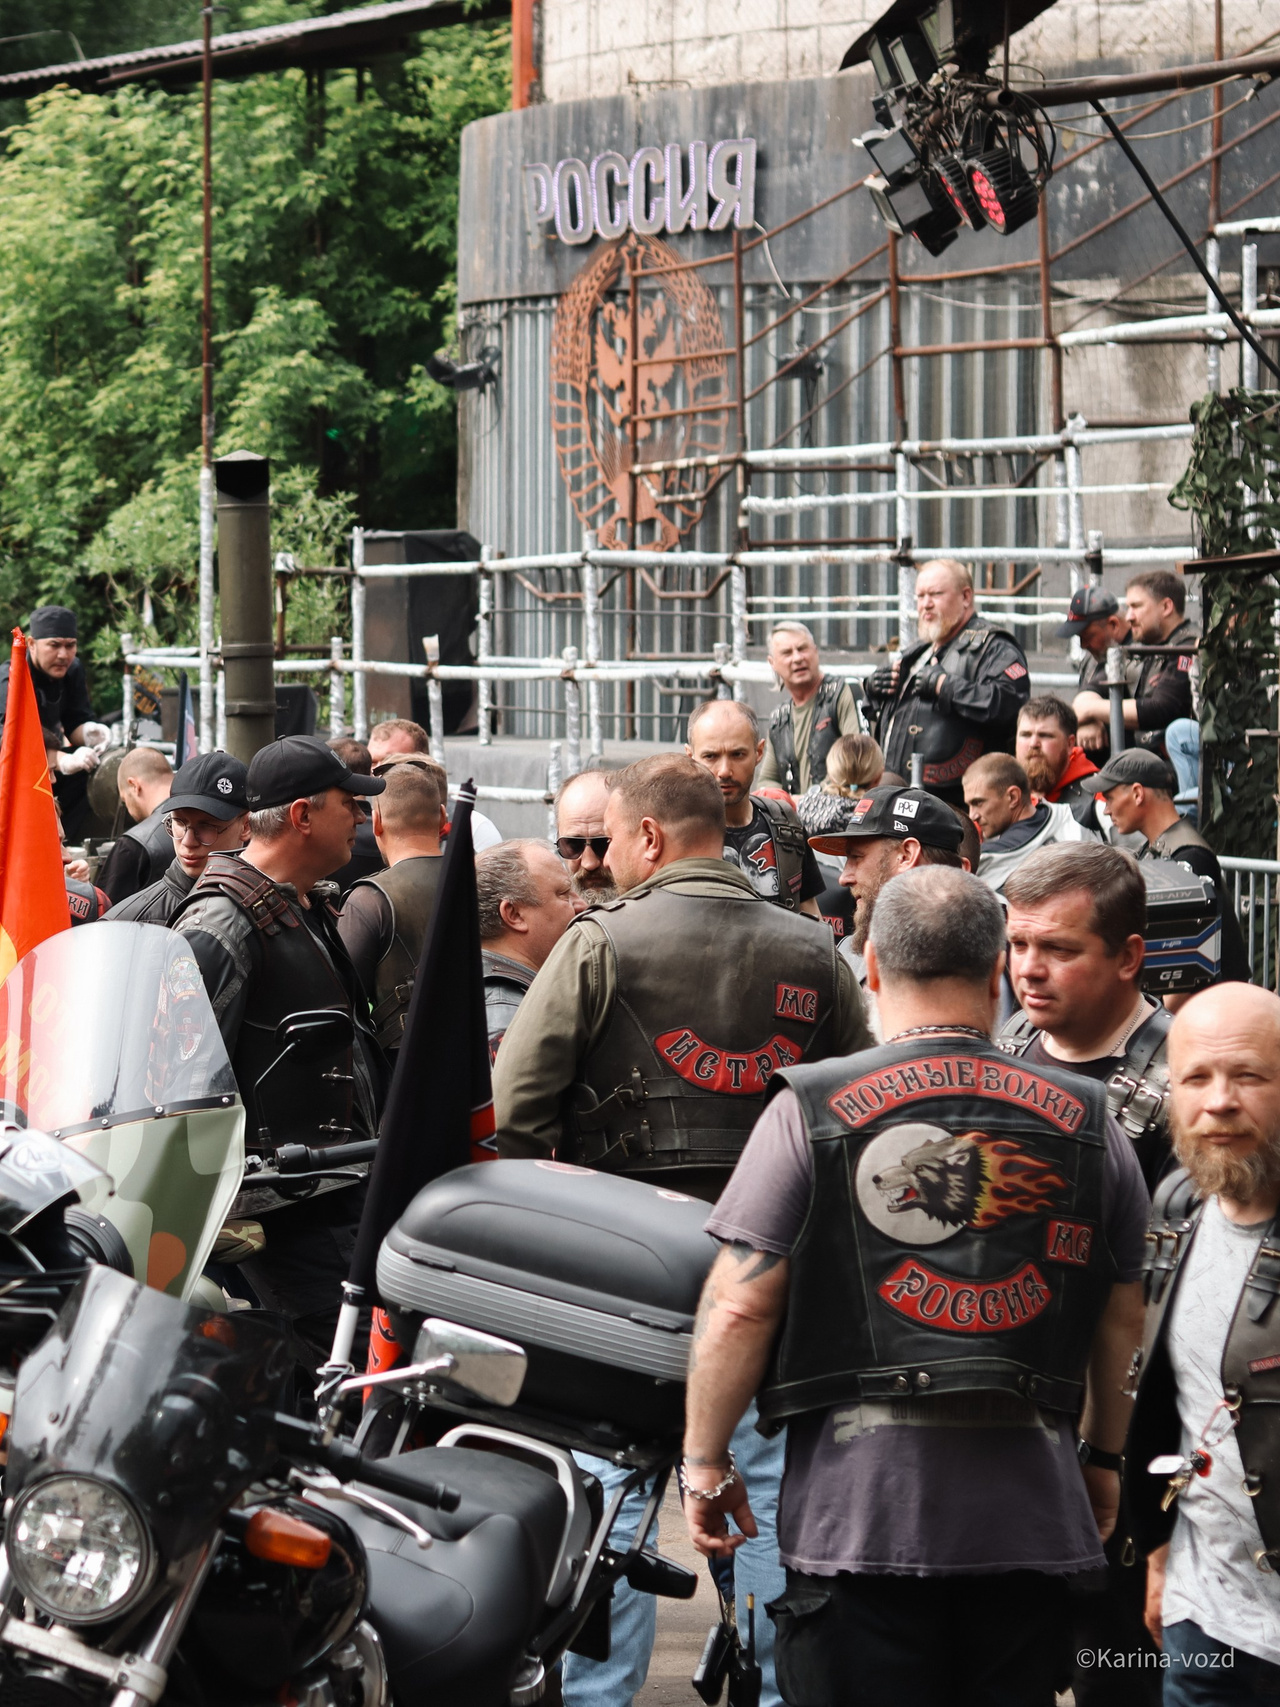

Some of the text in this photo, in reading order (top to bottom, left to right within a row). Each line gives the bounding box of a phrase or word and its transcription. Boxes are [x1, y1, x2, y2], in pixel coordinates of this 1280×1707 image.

[522, 138, 757, 249] РОССИЯ
[1159, 969, 1183, 981] GS
[664, 1031, 796, 1088] ИСТРА
[833, 1059, 1083, 1131] НОЧНЫЕ ВОЛКИ
[885, 1267, 1050, 1327] РОССИЯ
